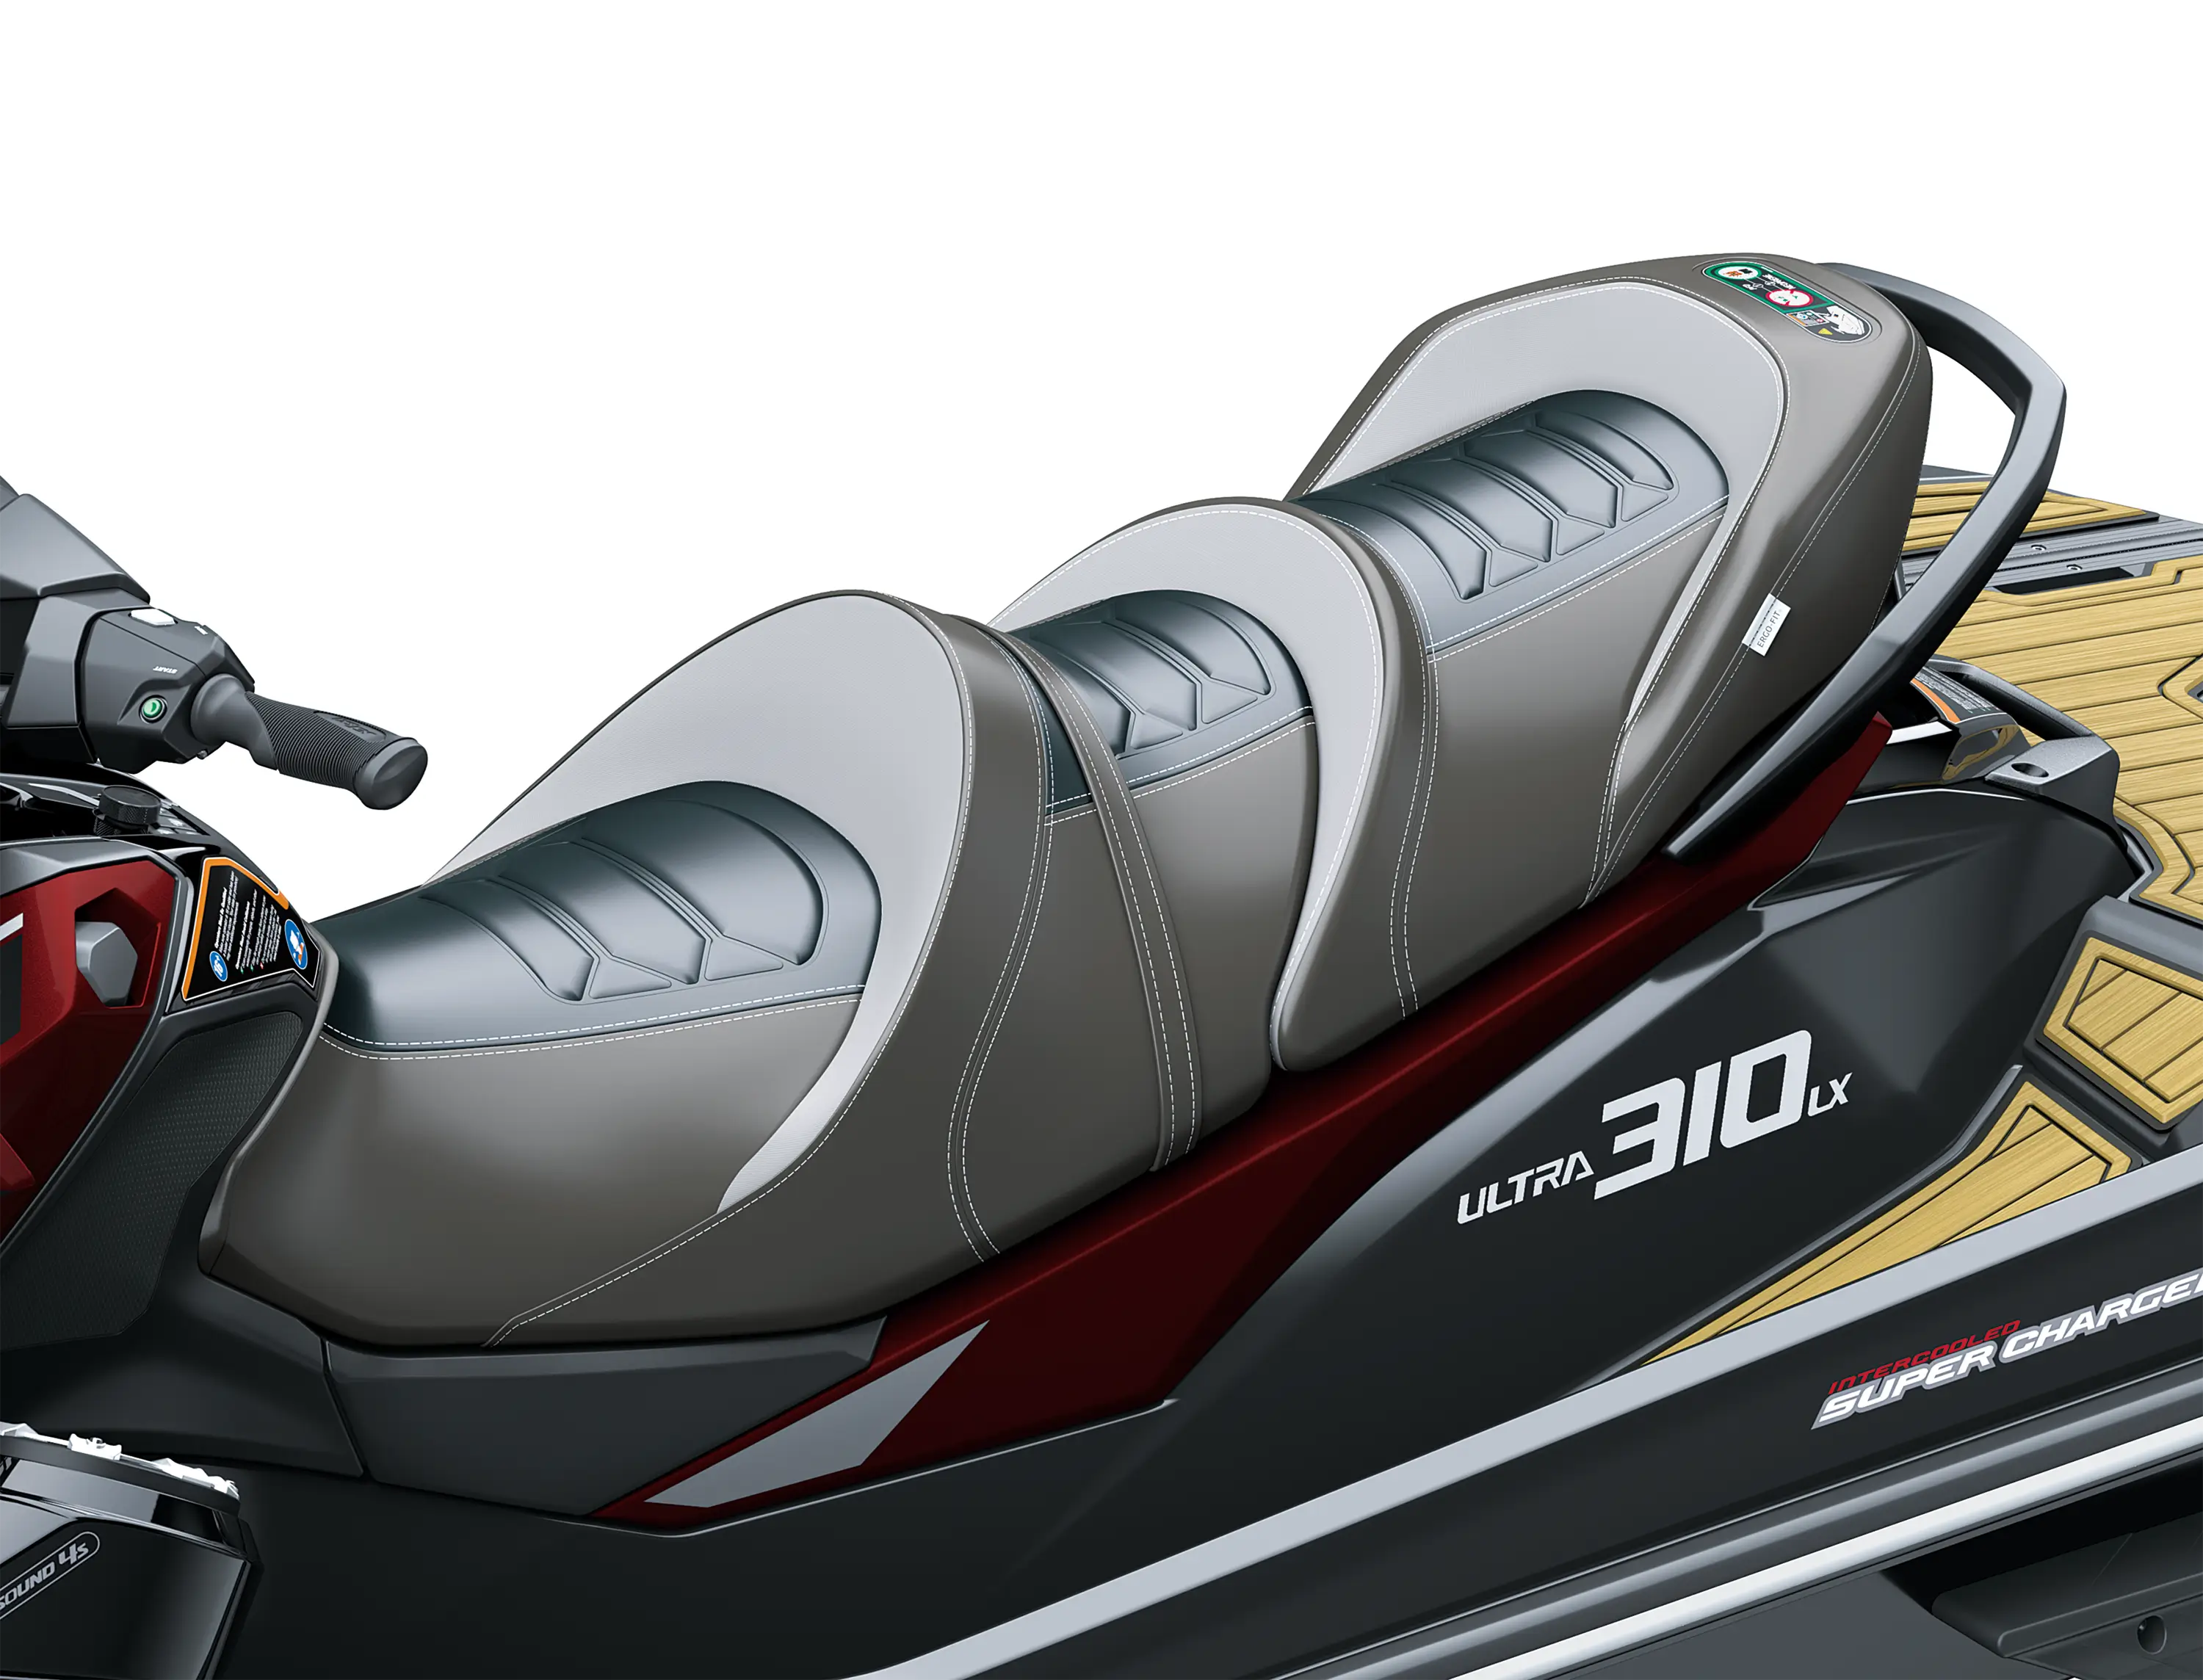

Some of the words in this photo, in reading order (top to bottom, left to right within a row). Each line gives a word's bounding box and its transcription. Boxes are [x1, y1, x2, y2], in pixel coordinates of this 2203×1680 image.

[1457, 1151, 1594, 1224] ULTRA
[1594, 1029, 1812, 1200] 310
[1808, 1072, 1853, 1117] LX
[1817, 1343, 1995, 1424] SUPER
[2000, 1271, 2203, 1360] CHARGE
[1828, 1320, 2021, 1395] INTERCOOLED
